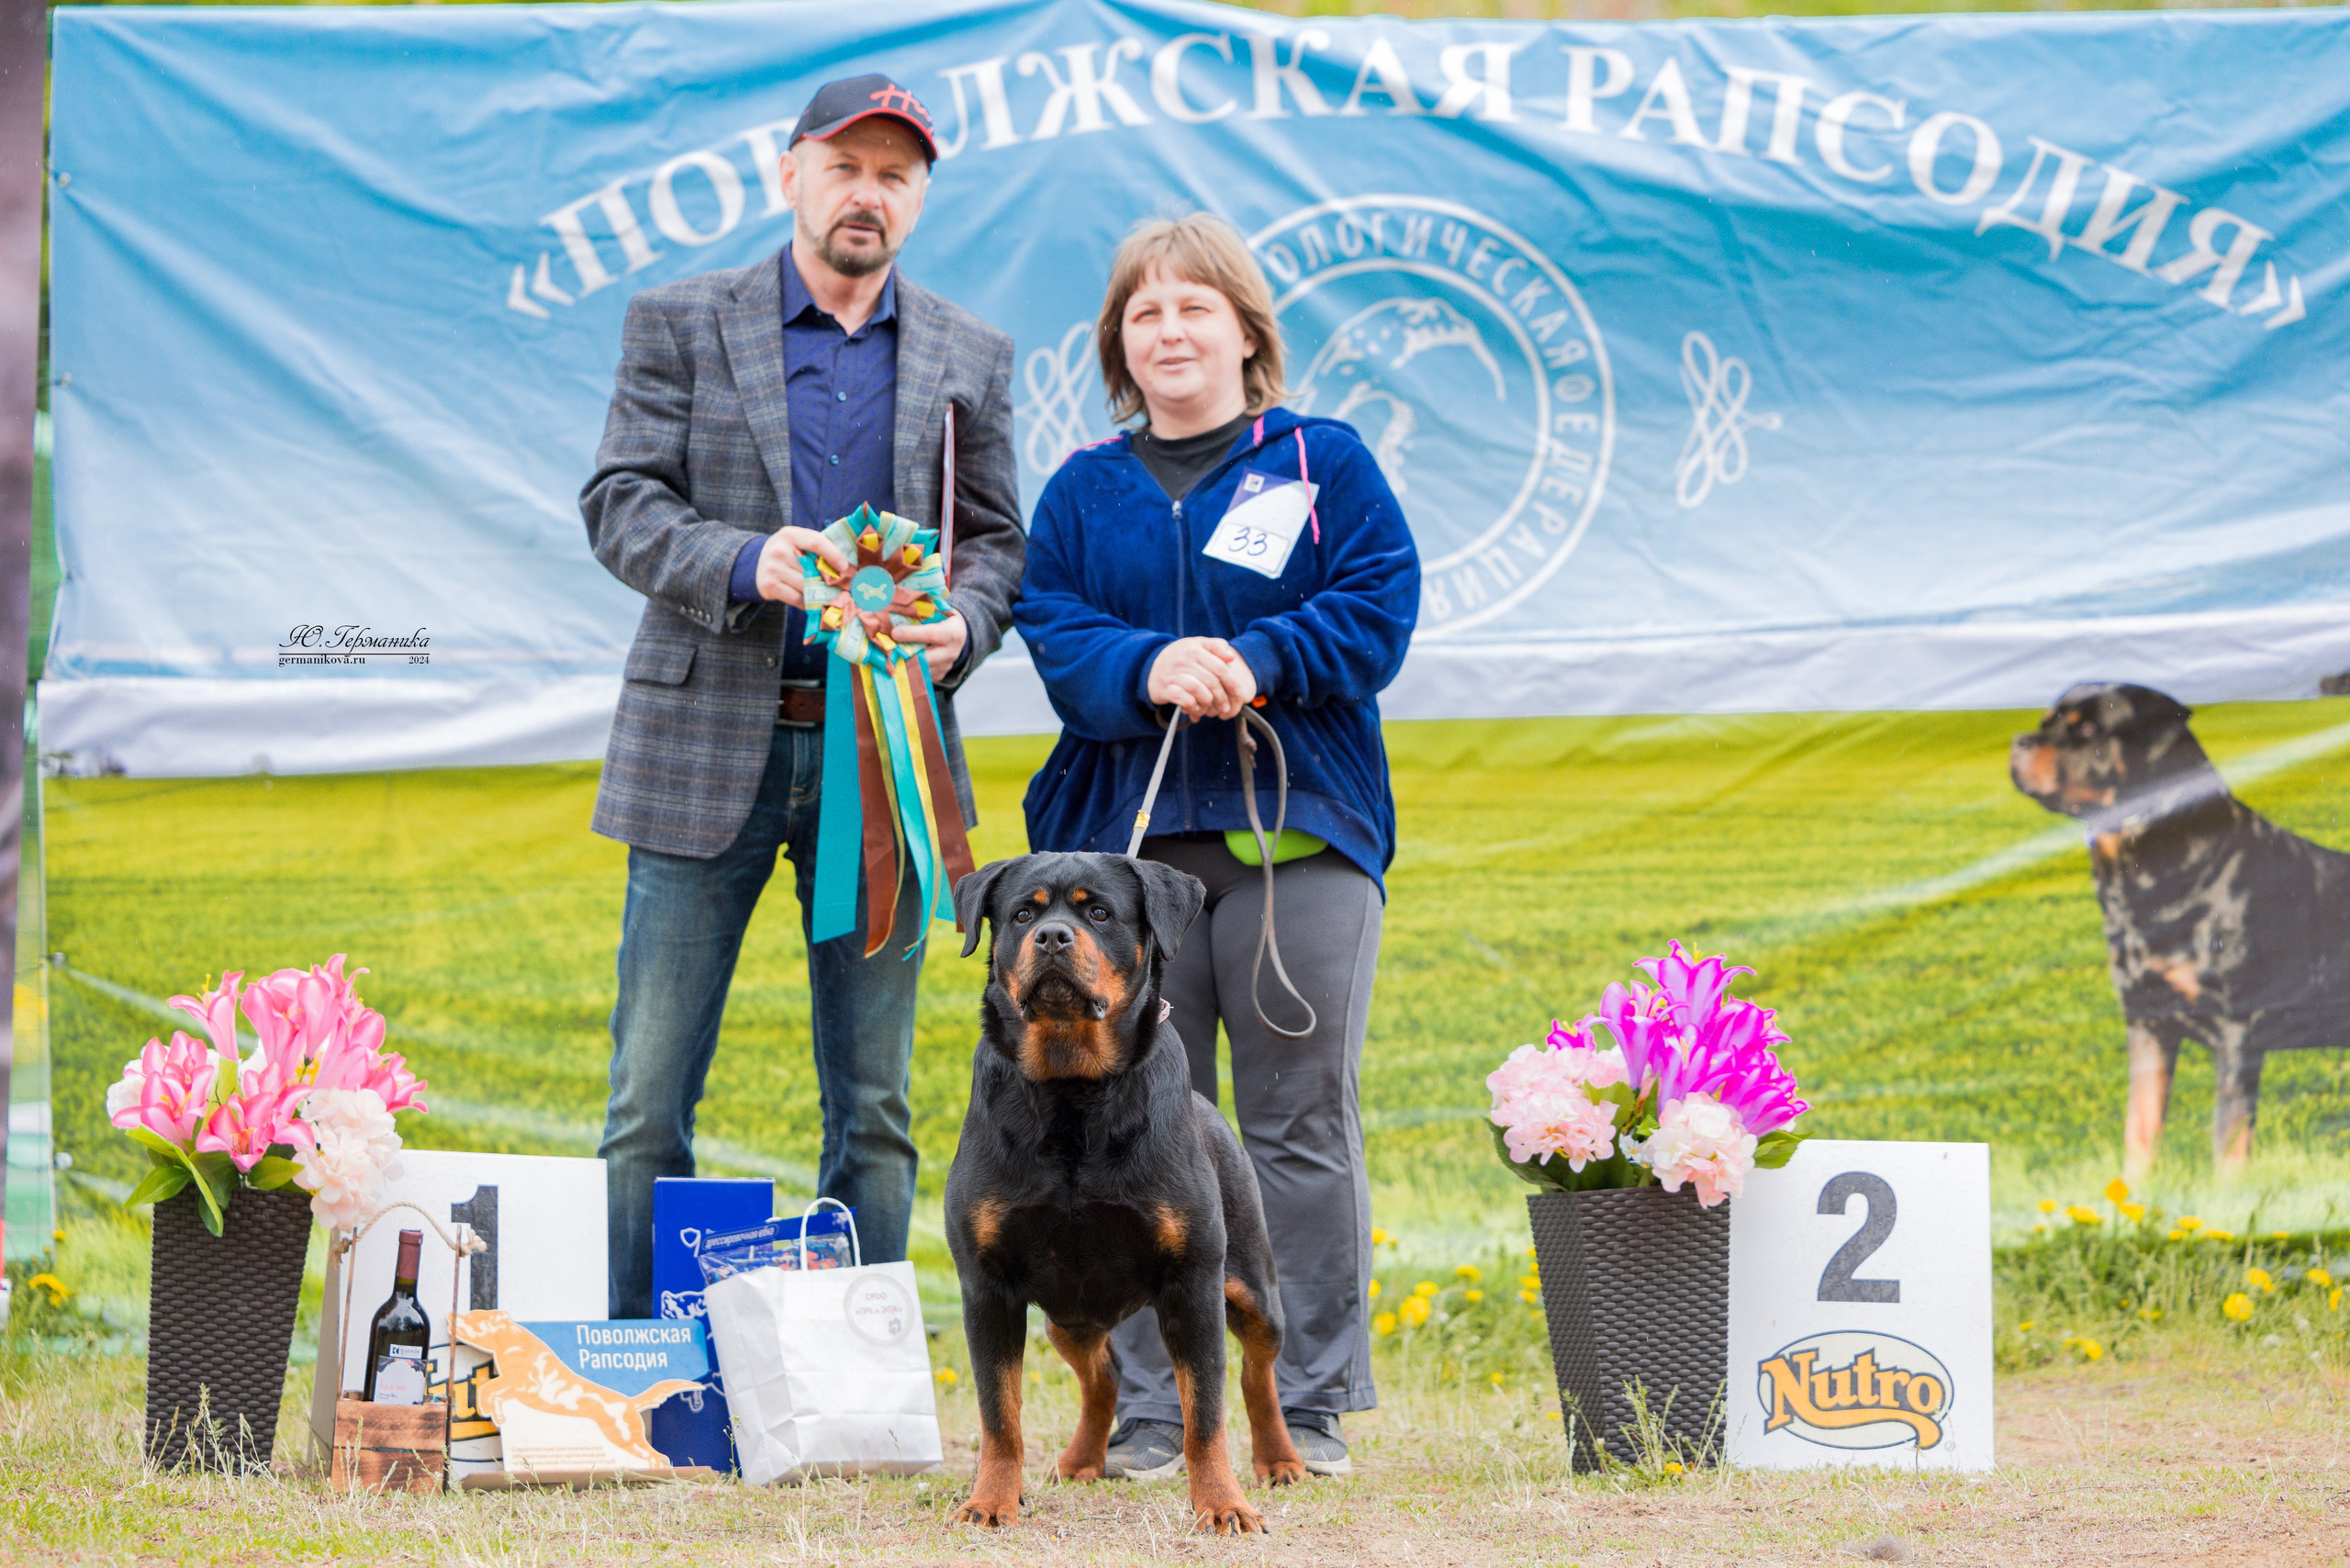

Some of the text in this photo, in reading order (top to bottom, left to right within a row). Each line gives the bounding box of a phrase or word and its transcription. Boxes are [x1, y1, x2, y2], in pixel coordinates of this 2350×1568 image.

[508, 29, 2307, 330] «ПОЛЖСКАЯ РАПСОДИЯ»
[1266, 212, 1589, 369] ОЛОГИЧЕСКАЯ
[1228, 526, 1268, 556] 33
[451, 1185, 498, 1311] 1
[1817, 1170, 1900, 1303] 2
[576, 1325, 691, 1345] Поволжская
[579, 1349, 667, 1372] Рапсодия
[1758, 1348, 1945, 1450] Nutro
